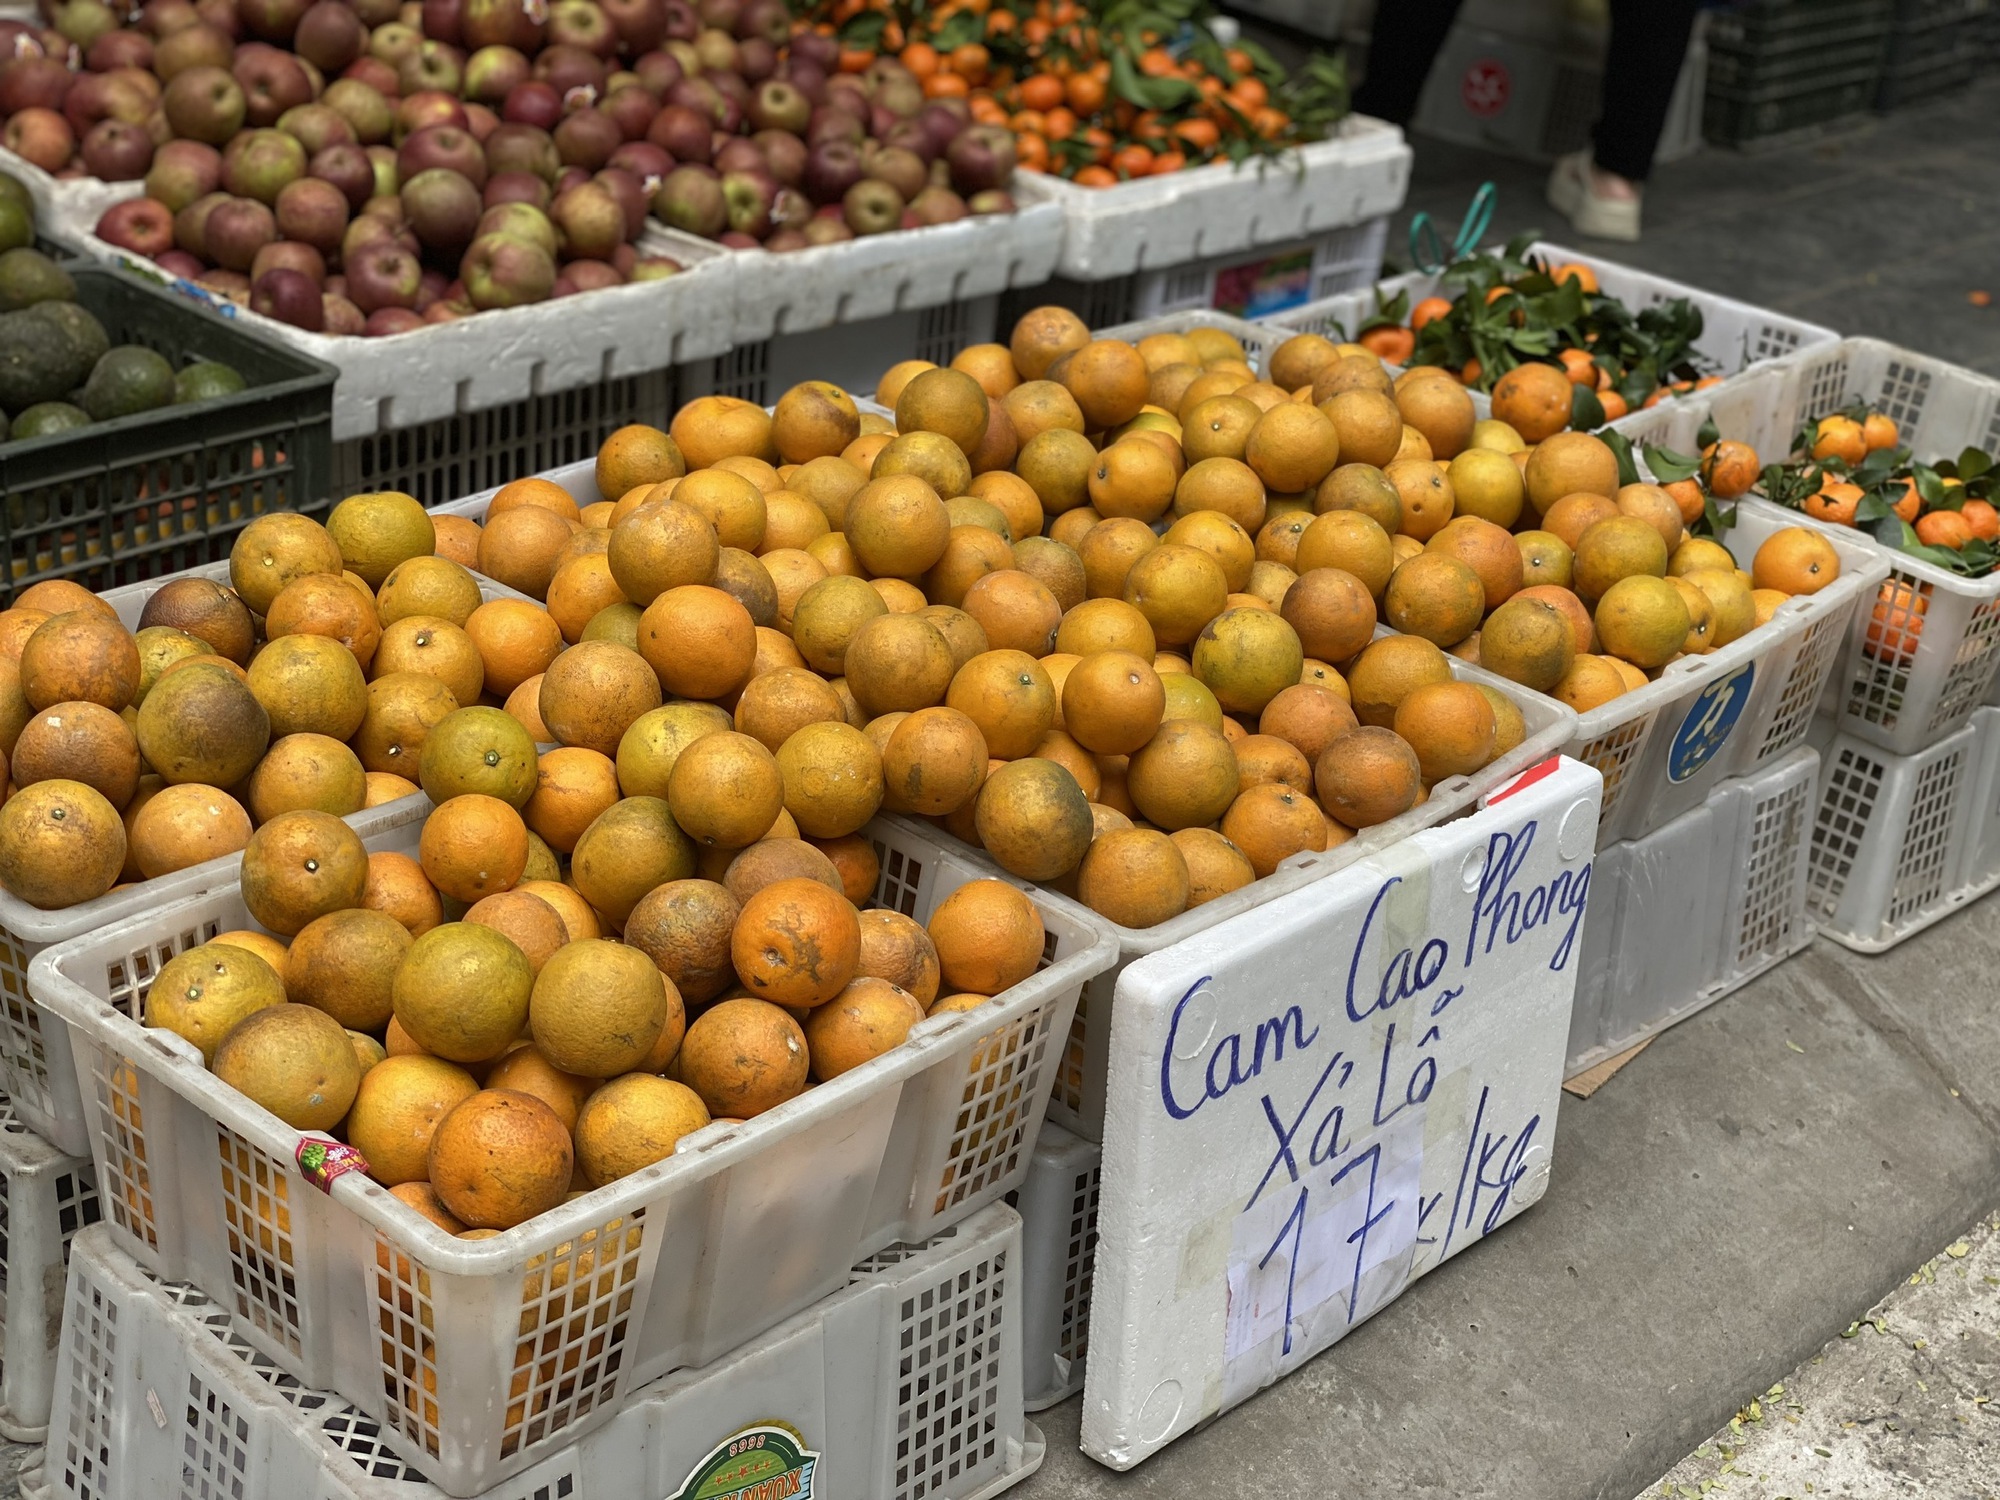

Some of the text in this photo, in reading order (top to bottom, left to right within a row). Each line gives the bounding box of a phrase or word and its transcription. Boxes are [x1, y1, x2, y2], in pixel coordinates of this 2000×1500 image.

[1161, 820, 1592, 1120] Cam Cao Phong
